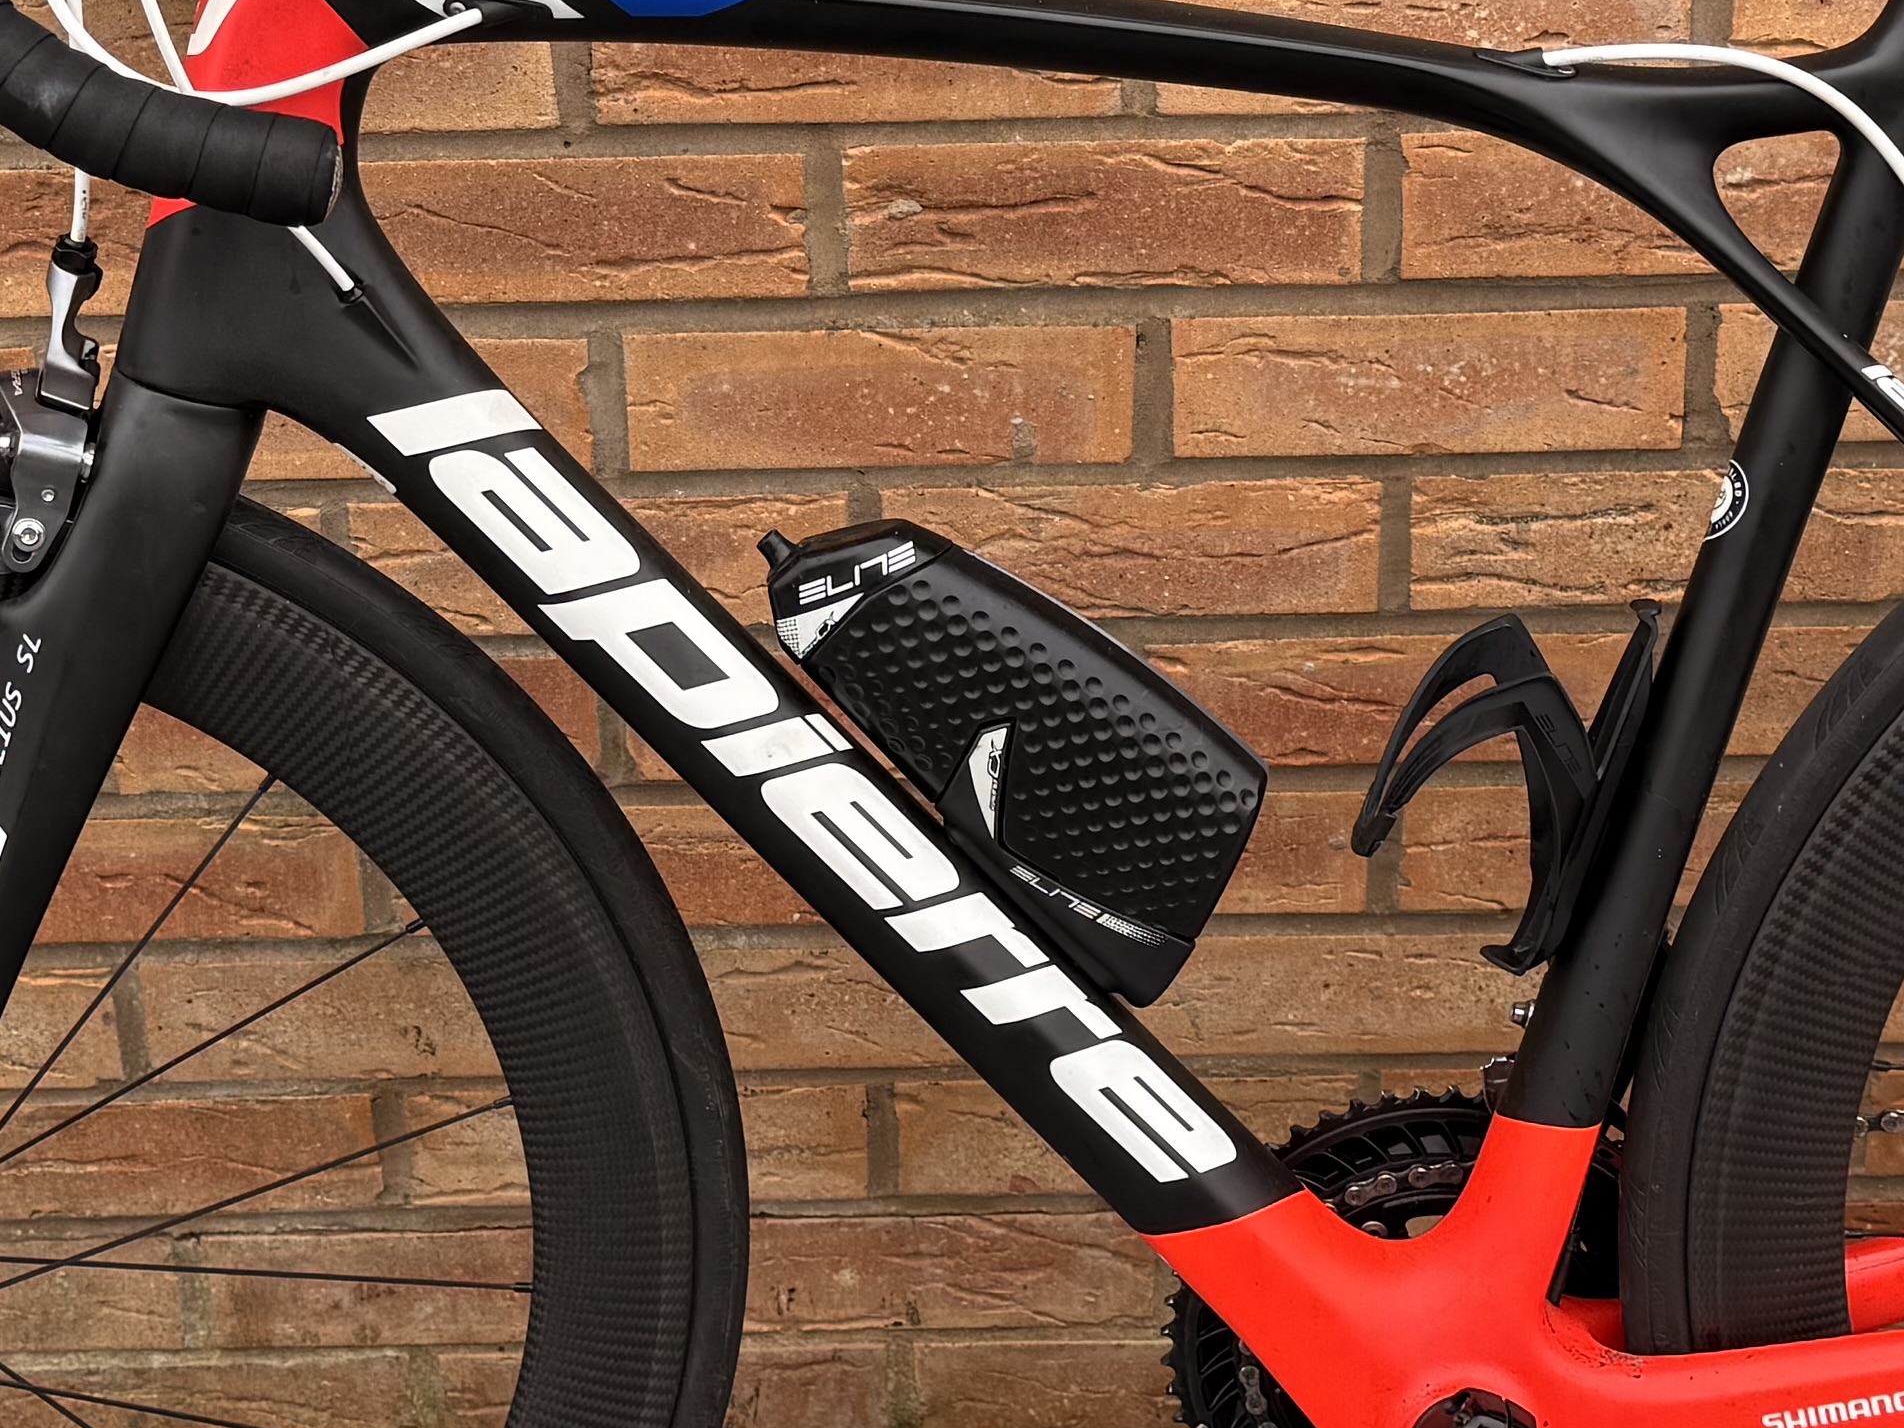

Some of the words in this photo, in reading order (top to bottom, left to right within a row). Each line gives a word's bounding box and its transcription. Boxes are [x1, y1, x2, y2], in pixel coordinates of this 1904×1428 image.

[798, 540, 917, 605] ELITE
[16, 633, 42, 674] SL
[366, 389, 1238, 1183] lapierre
[1010, 865, 1101, 920] ELITE
